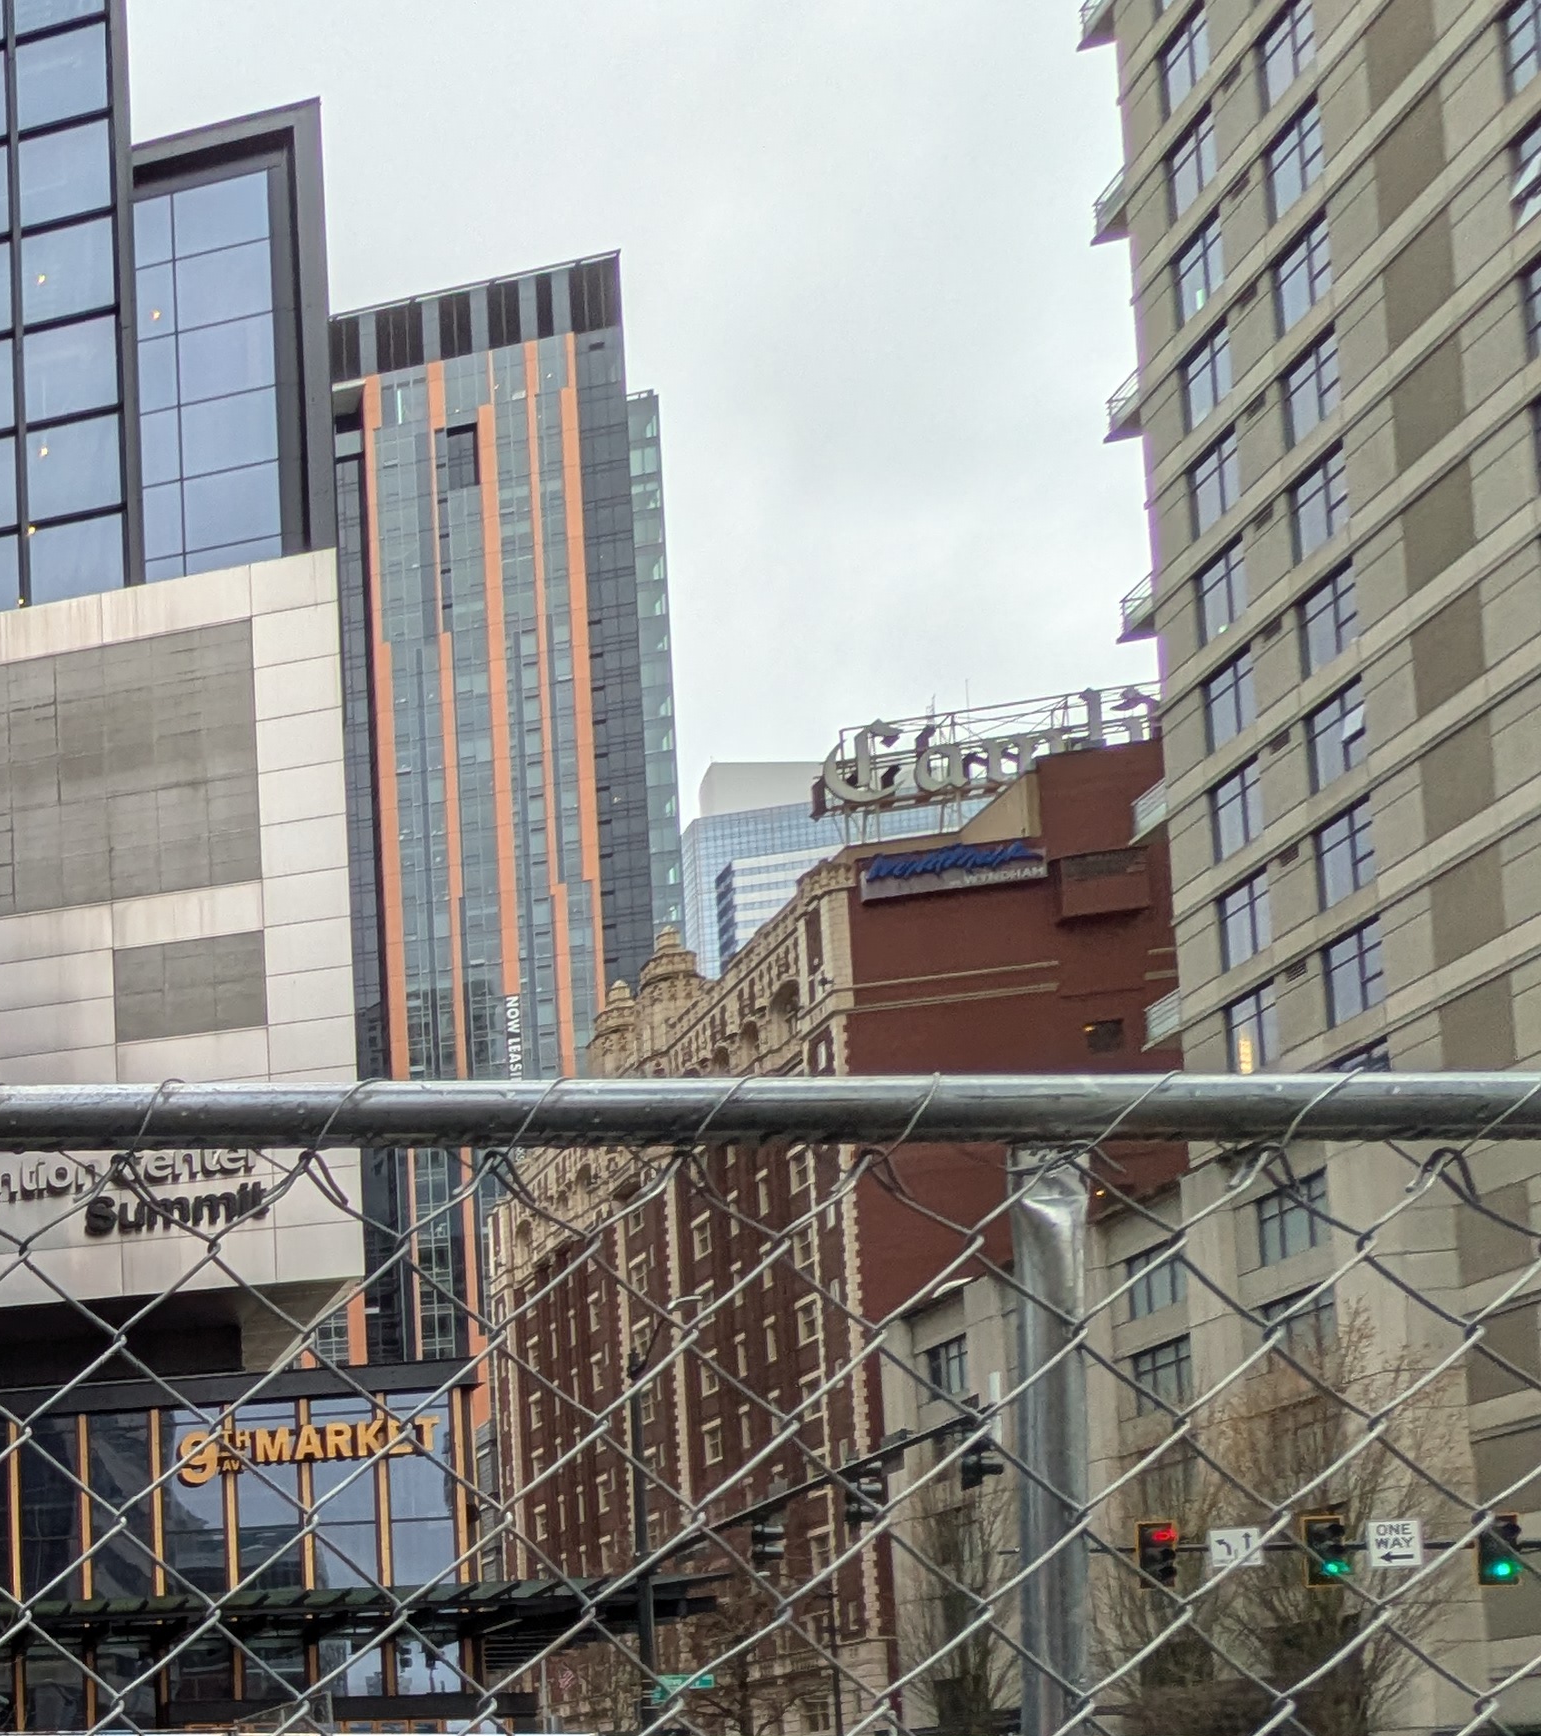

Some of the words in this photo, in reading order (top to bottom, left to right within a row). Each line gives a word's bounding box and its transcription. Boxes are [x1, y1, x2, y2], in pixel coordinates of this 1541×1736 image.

[505, 995, 521, 1033] NOW
[83, 1180, 271, 1237] Summit
[255, 1415, 442, 1463] MARKET
[1374, 1536, 1416, 1550] WAY
[1376, 1523, 1413, 1536] ONE
